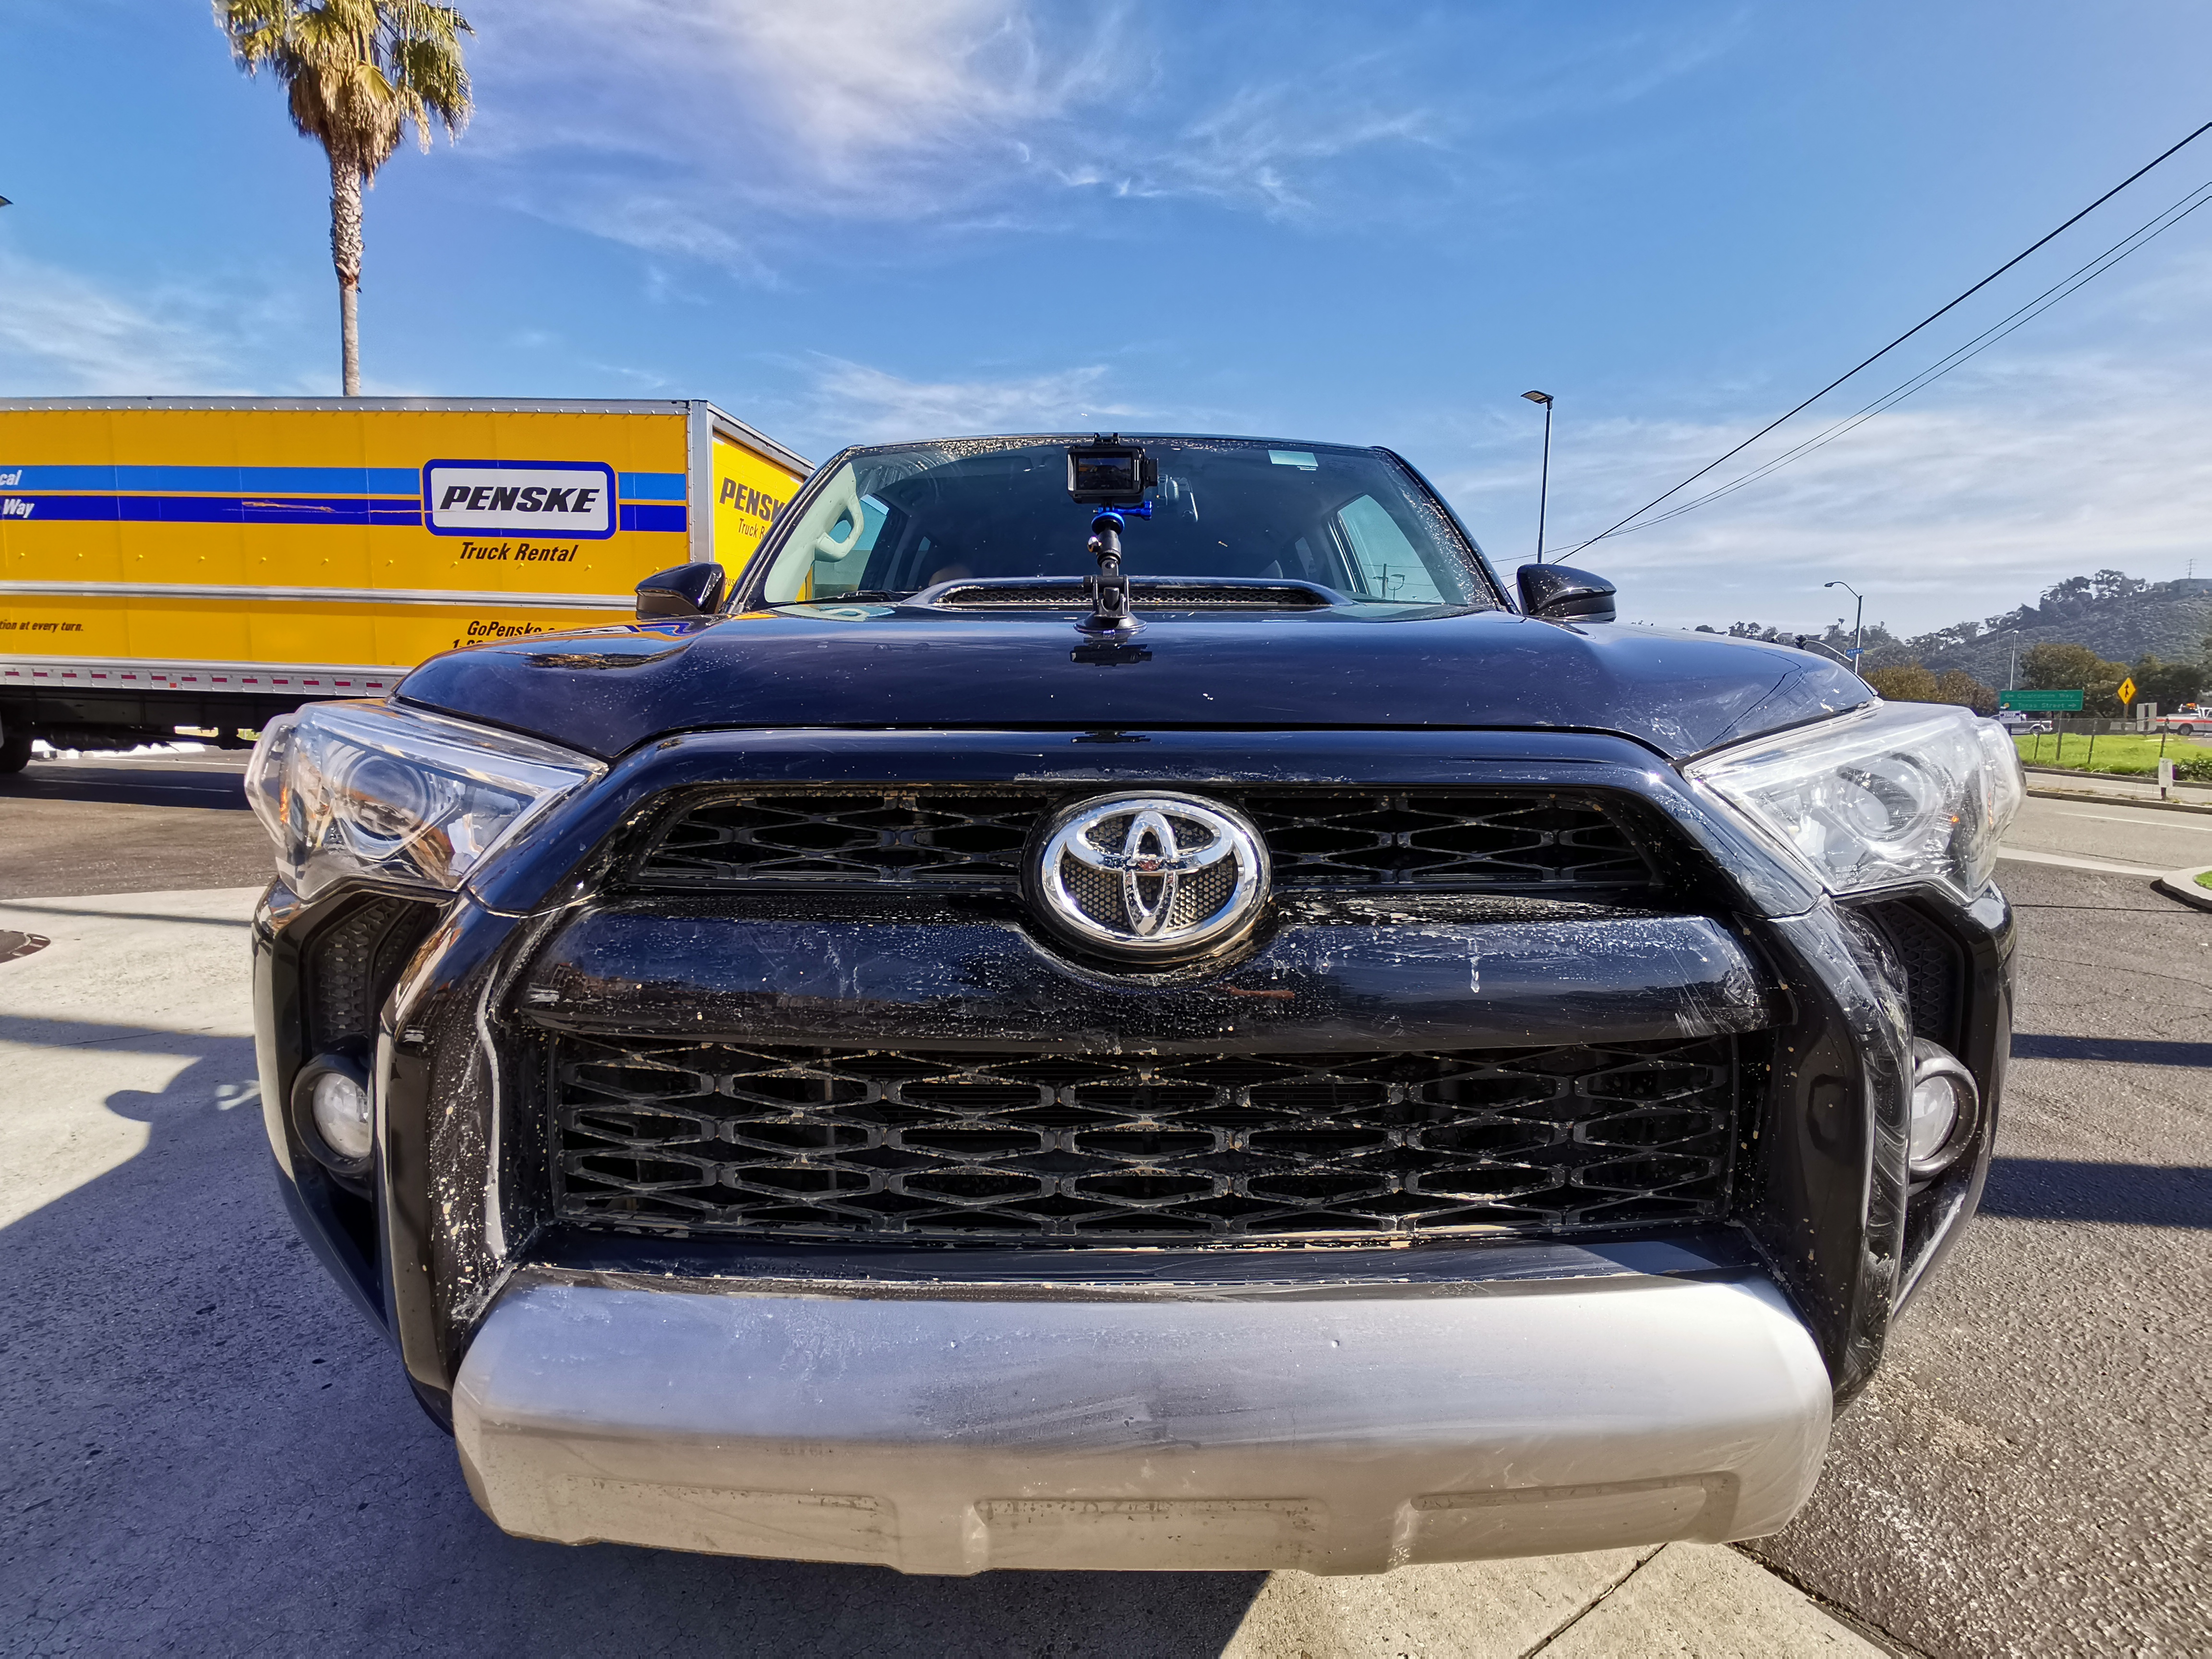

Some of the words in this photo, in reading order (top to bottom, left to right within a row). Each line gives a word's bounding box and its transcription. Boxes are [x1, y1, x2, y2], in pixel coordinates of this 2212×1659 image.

[3, 499, 35, 518] Way
[440, 486, 600, 512] PENSKE
[738, 518, 759, 538] Truck
[460, 542, 511, 560] Truck
[514, 543, 579, 562] Rental
[19, 622, 30, 630] at
[32, 623, 60, 633] every
[61, 622, 84, 631] turn.
